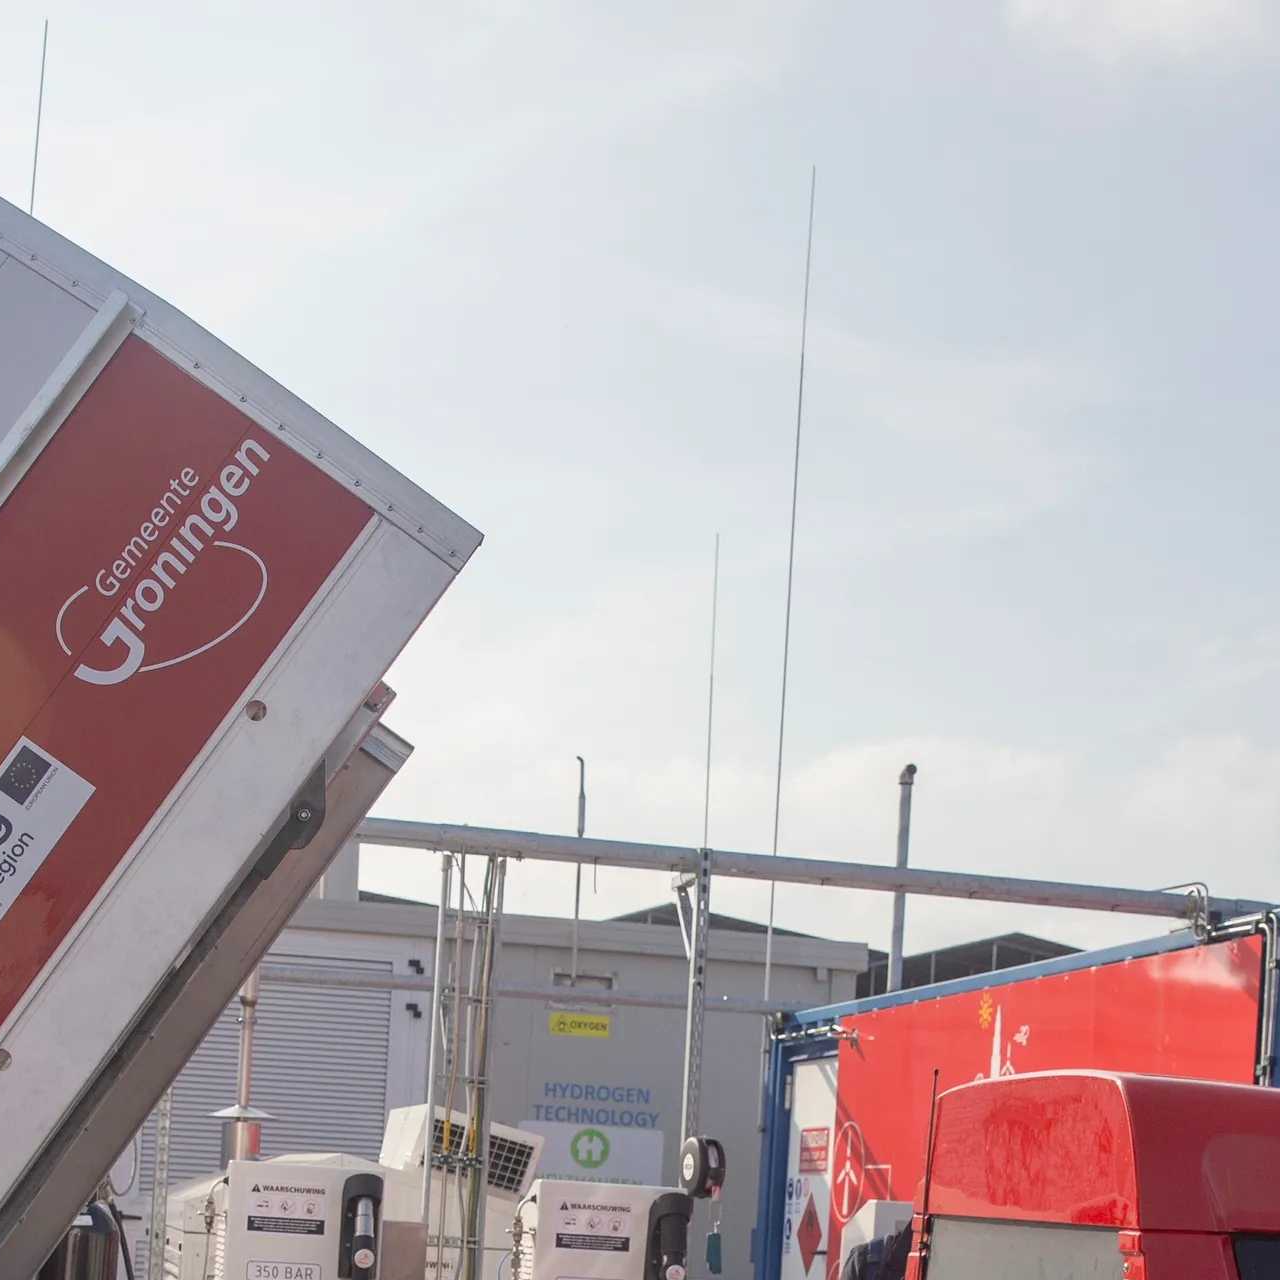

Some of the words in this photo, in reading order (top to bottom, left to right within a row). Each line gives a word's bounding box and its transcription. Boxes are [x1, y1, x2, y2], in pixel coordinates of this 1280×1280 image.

[95, 466, 200, 597] Gemeente
[73, 438, 271, 685] Groningen
[24, 782, 47, 811] EUROPEAN
[44, 766, 59, 784] UNION
[569, 1020, 607, 1031] OXYGEN
[543, 1081, 651, 1104] HYDROGEN
[532, 1104, 660, 1128] TECHNOLOGY
[261, 1184, 326, 1196] WAARSCHUWING
[569, 1202, 632, 1213] WAARSCHUWING
[254, 1264, 280, 1280] 350
[284, 1266, 314, 1280] BAR
